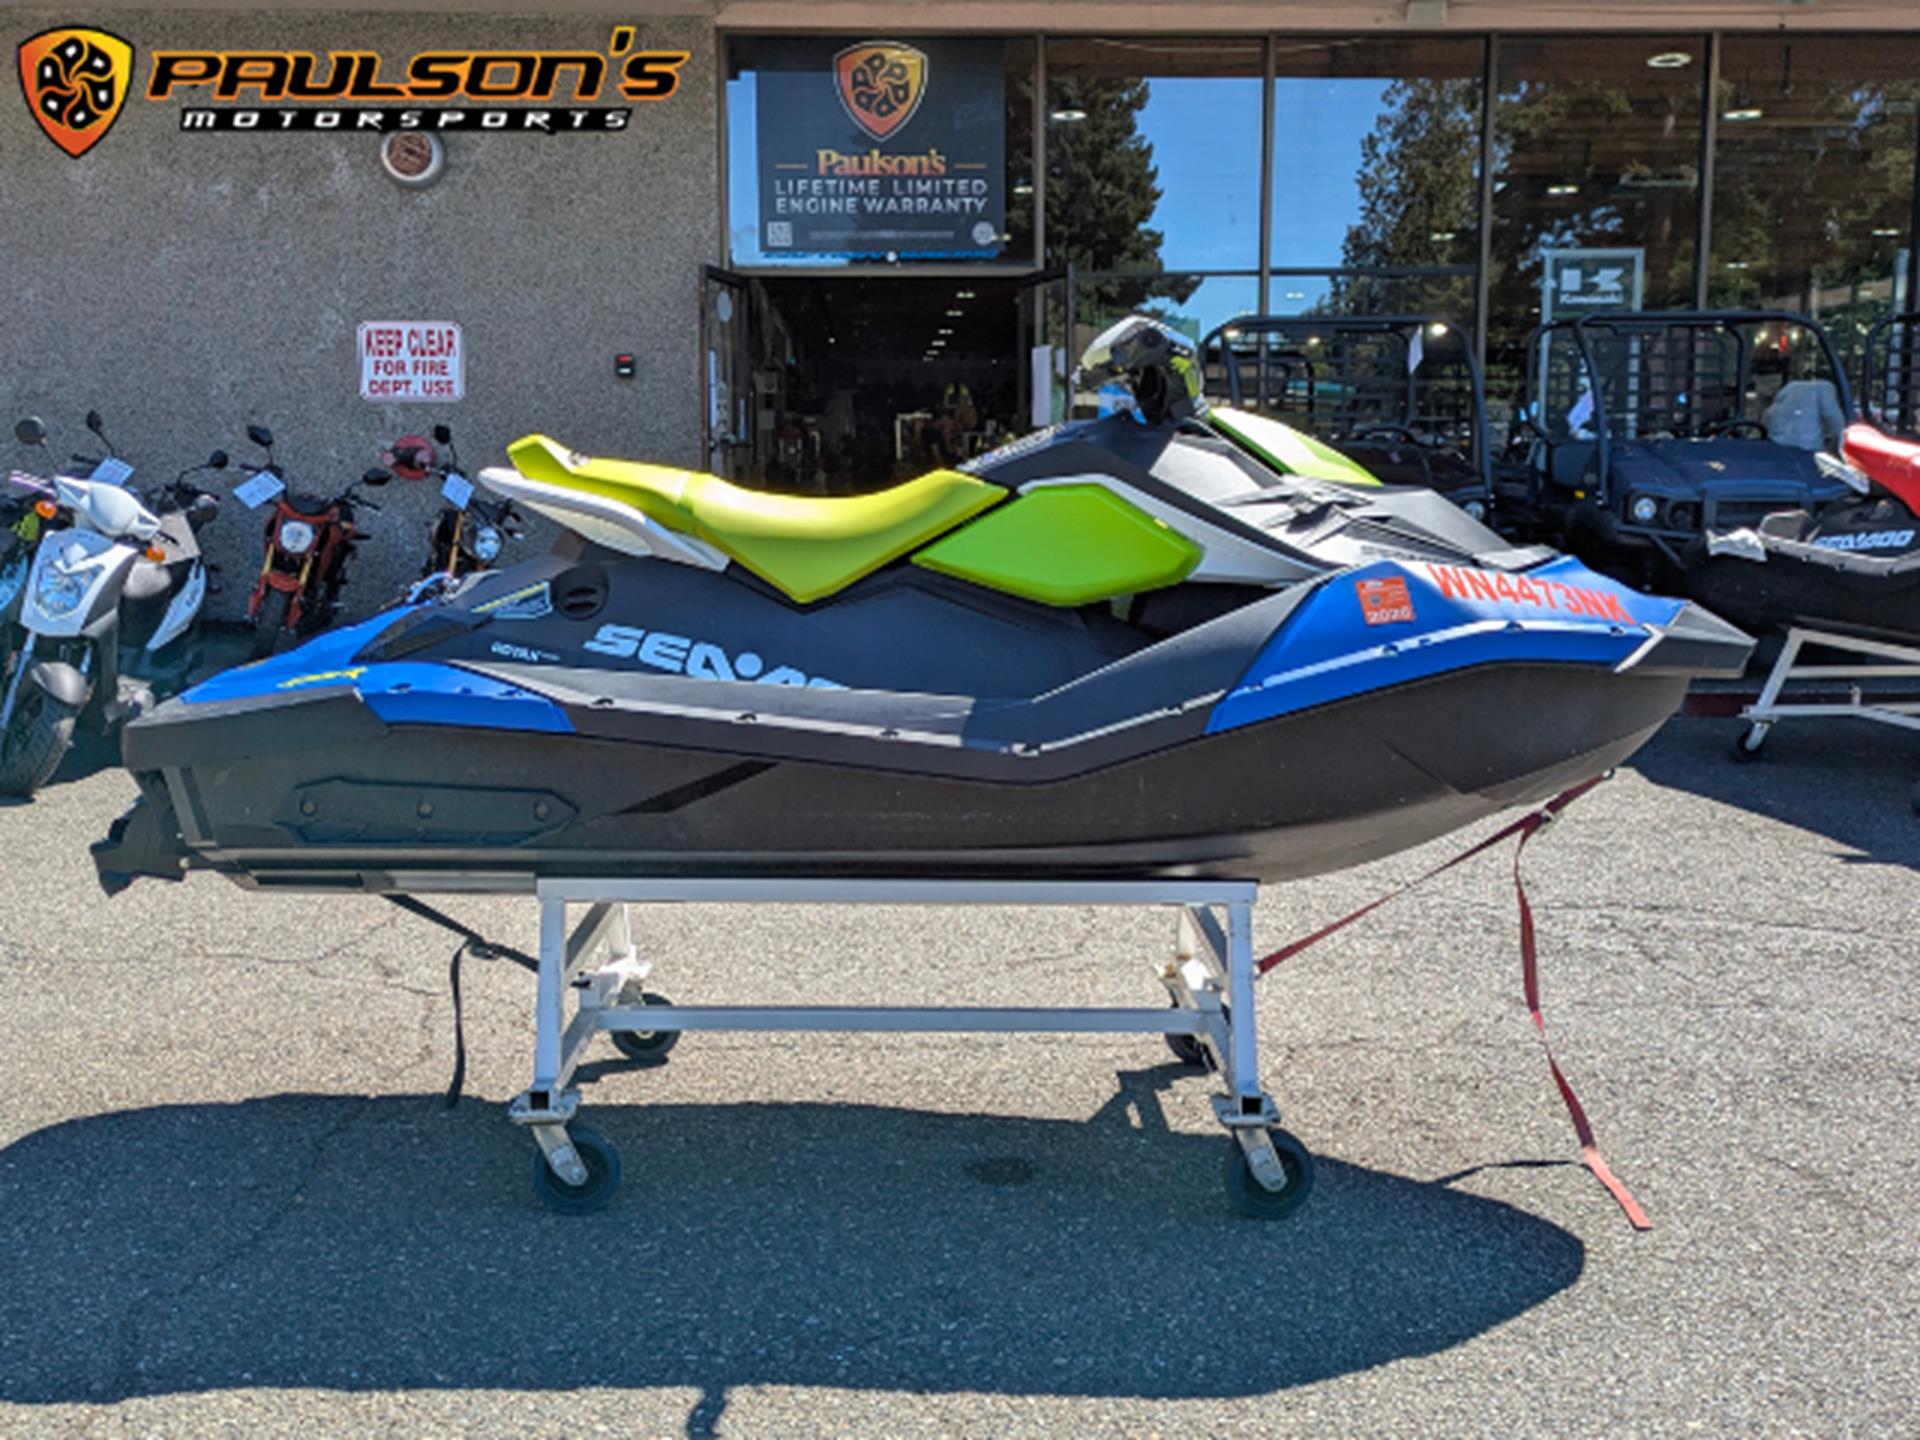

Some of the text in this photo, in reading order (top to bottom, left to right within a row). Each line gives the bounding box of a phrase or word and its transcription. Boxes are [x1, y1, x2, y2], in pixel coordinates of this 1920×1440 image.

[816, 149, 947, 176] Paulson's
[775, 179, 988, 196] LIFETIME LIMITED
[776, 198, 988, 214] ENGINE WARRANTY
[366, 328, 457, 357] KEEP CLEAR
[374, 360, 450, 376] FOR FIRE
[422, 379, 455, 395] USE
[1426, 563, 1636, 626] WN4473NK
